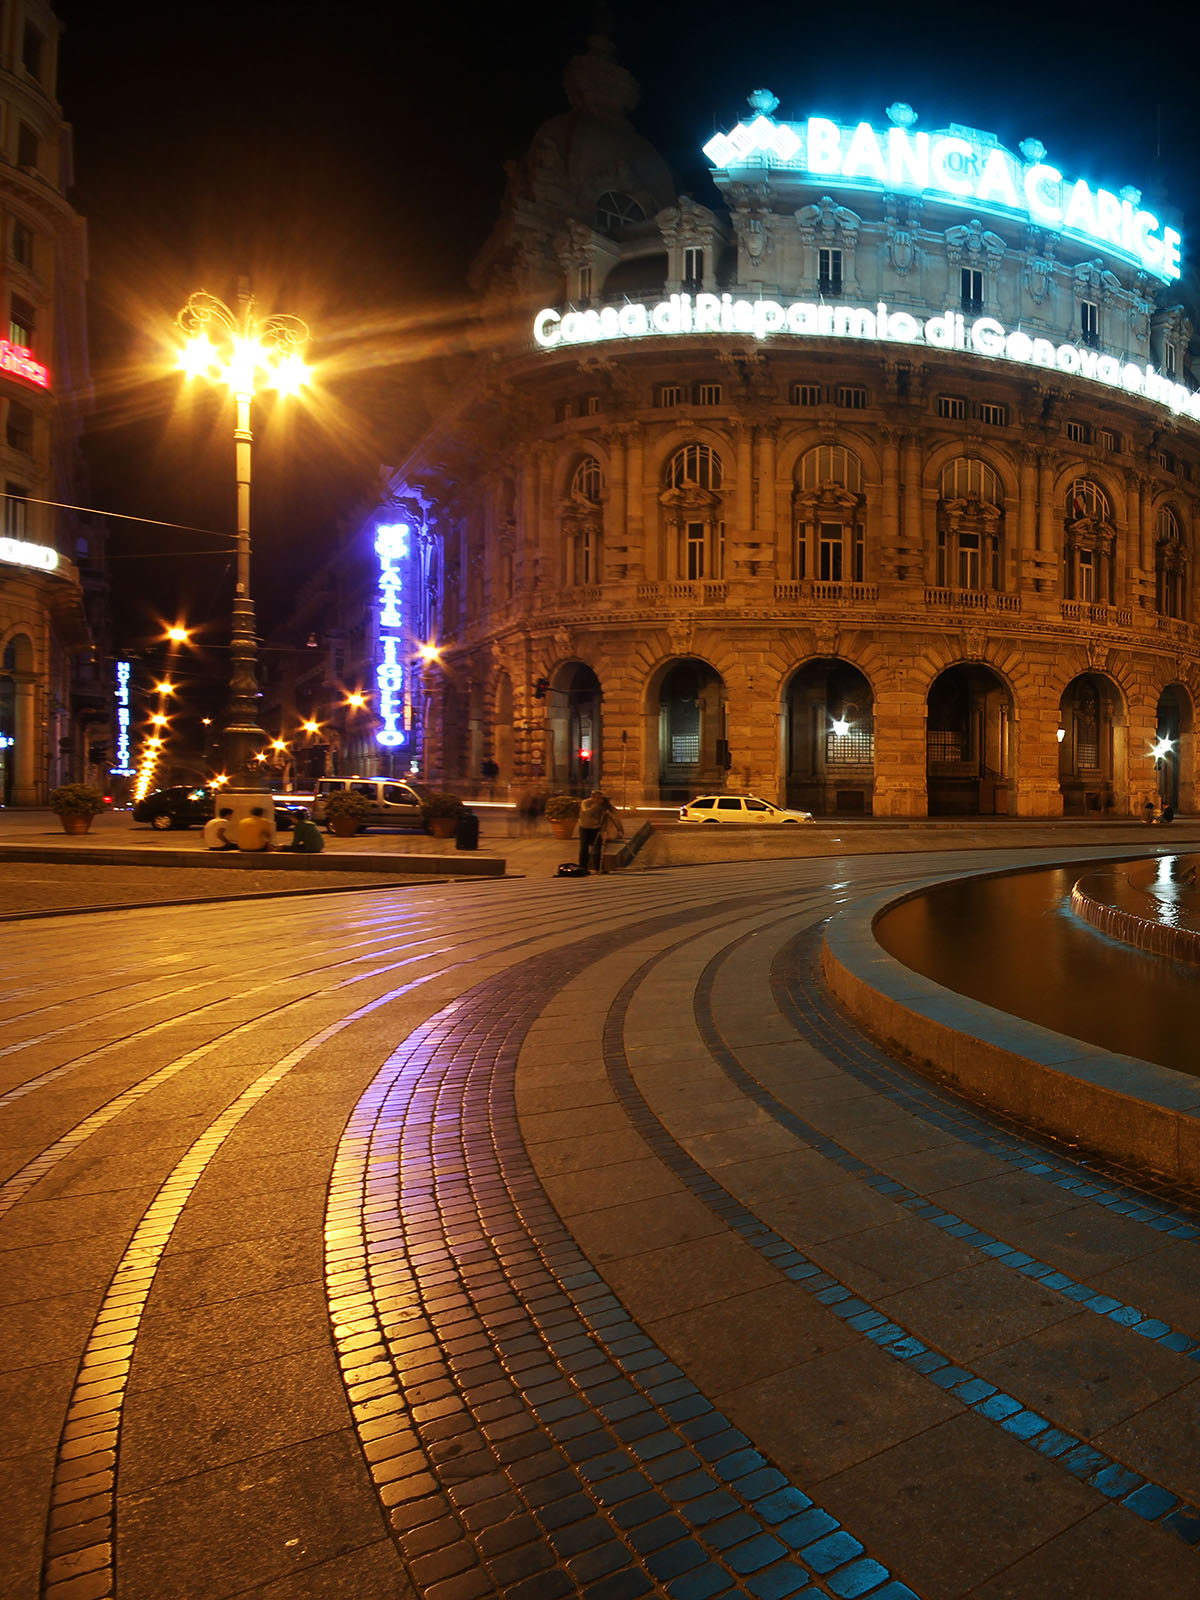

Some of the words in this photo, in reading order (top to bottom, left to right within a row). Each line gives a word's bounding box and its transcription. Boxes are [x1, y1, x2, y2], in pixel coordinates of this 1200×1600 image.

[807, 116, 1019, 208] BANCA
[1024, 163, 1181, 279] CARIGE
[653, 293, 691, 332] di
[695, 292, 918, 341] Risparmio
[925, 310, 964, 348] di
[971, 317, 1120, 386] Genova
[379, 556, 402, 627] LATTE
[376, 635, 405, 746] TIGULLIO
